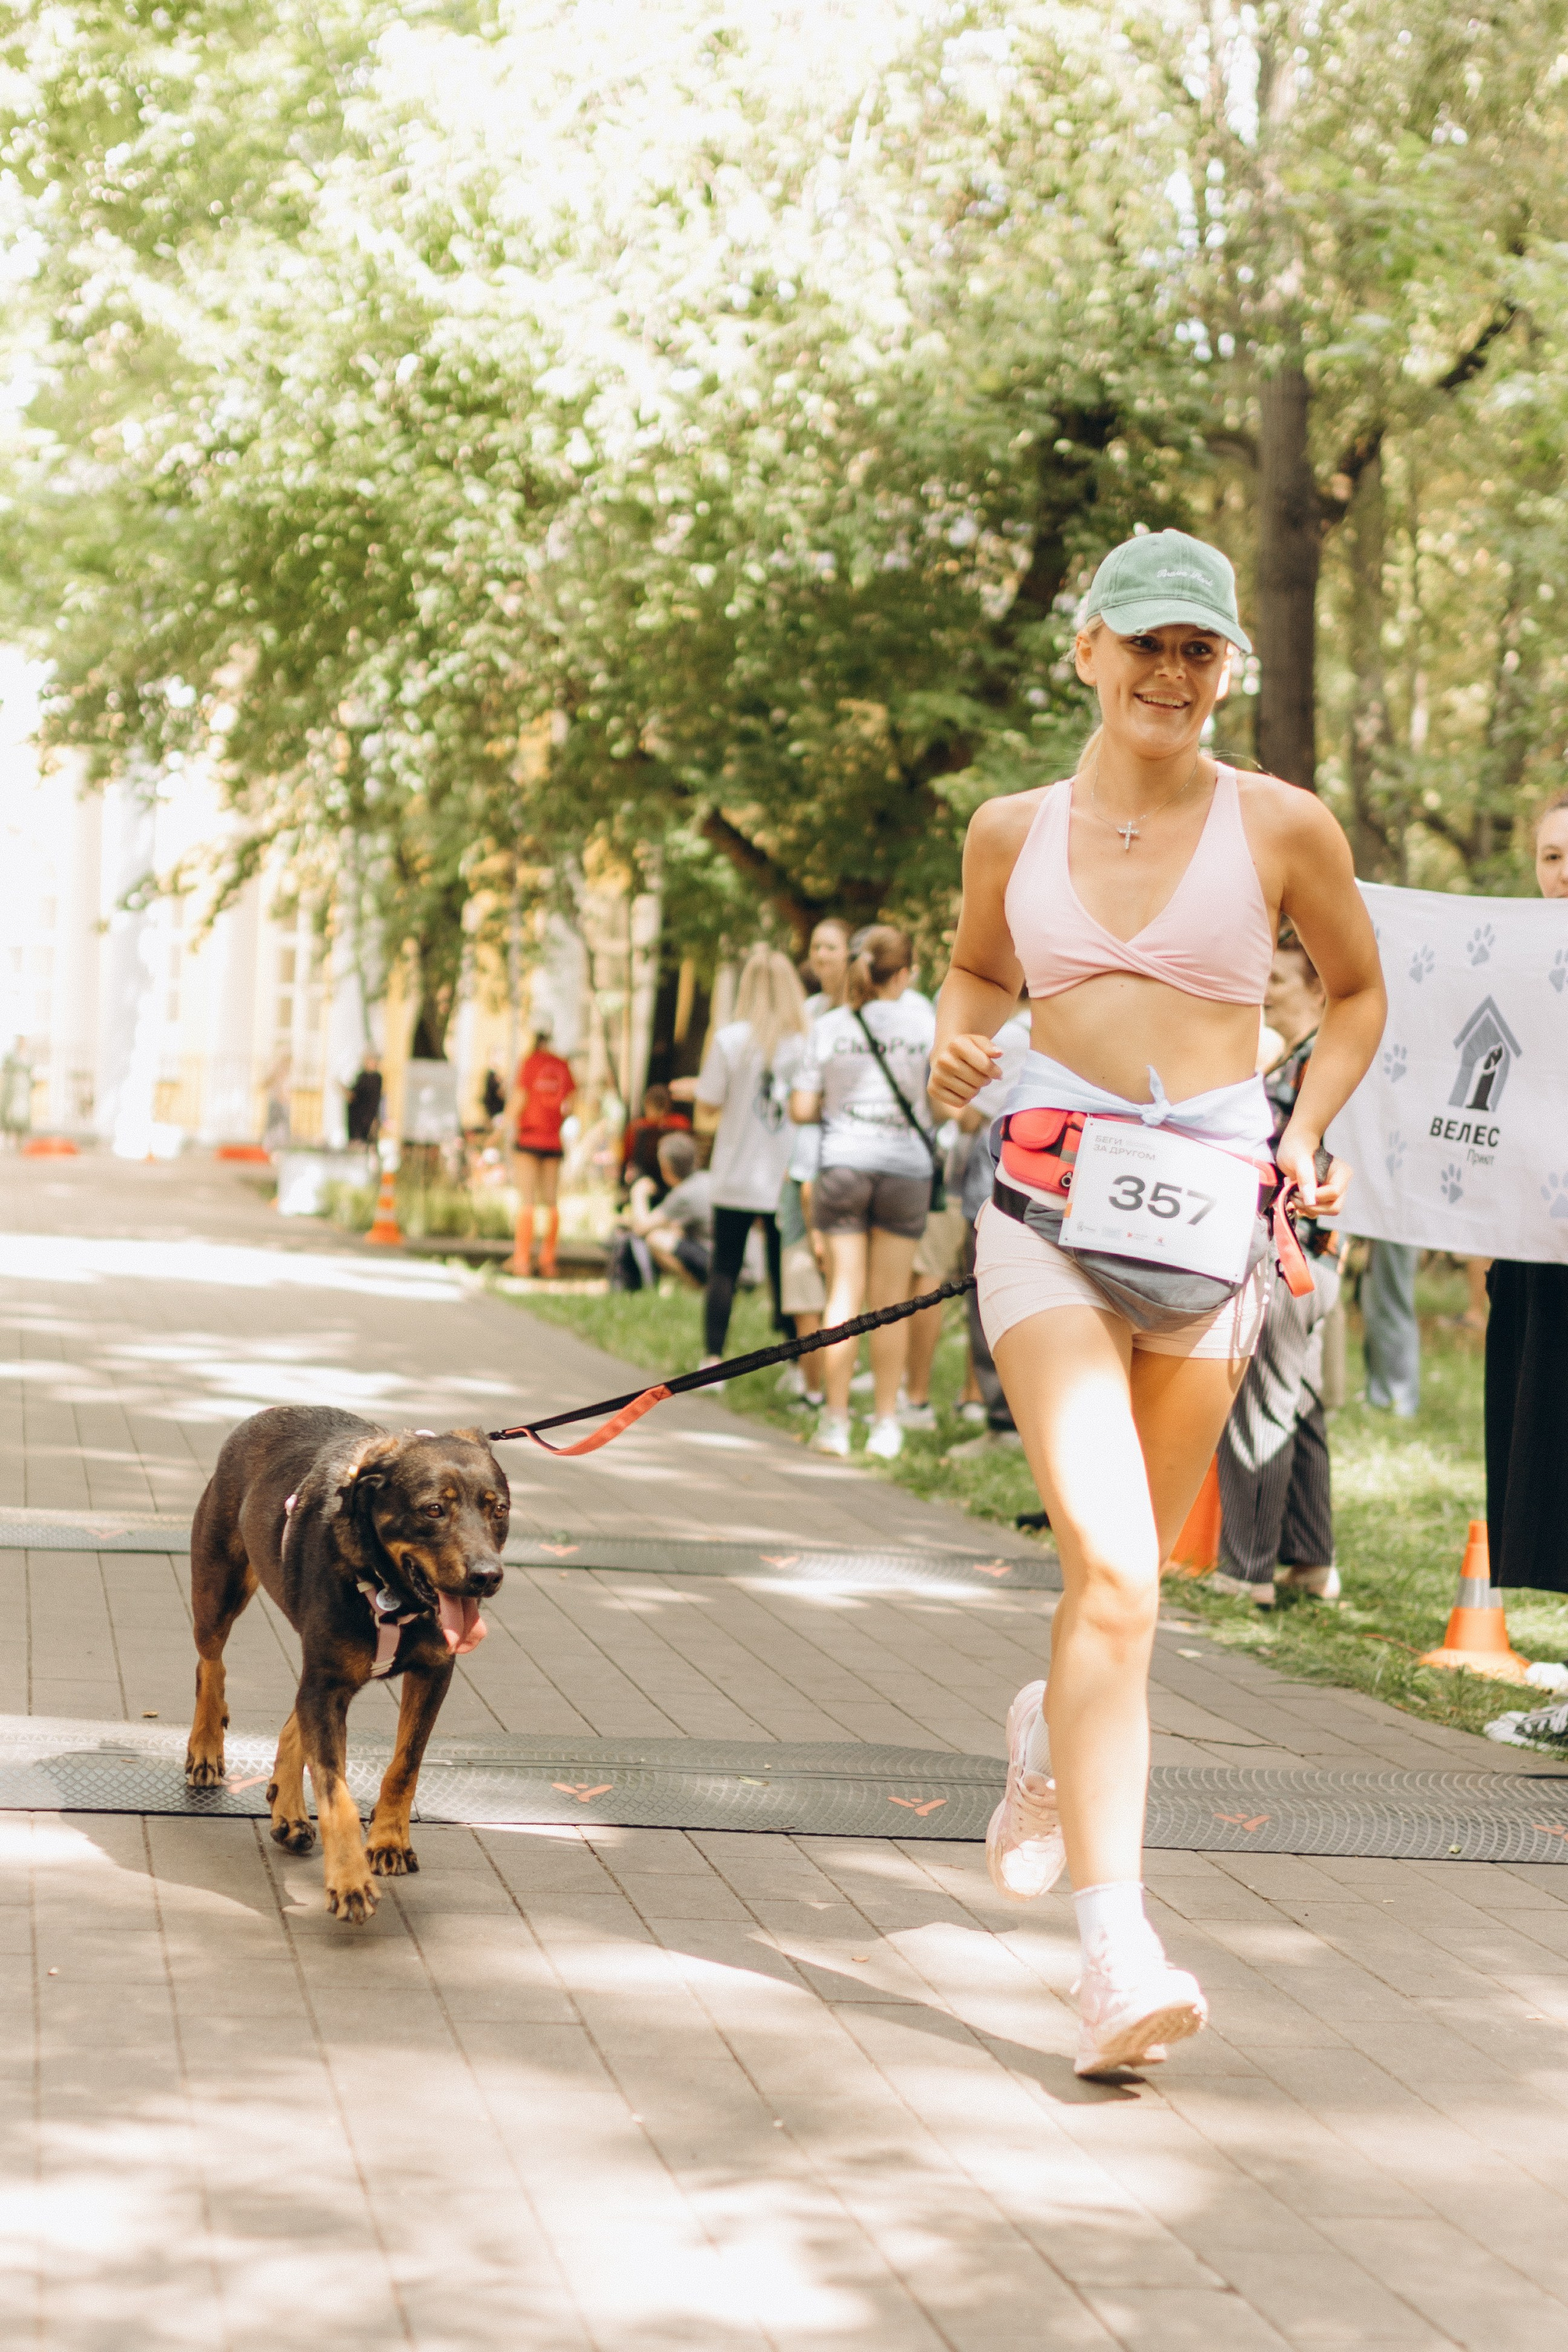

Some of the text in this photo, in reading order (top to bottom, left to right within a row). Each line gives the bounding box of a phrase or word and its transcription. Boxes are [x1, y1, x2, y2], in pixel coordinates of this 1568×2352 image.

[1095, 1135, 1122, 1146] БЕГИ
[1429, 1116, 1501, 1148] ВЕЛЕС
[1093, 1144, 1107, 1153] ЗА
[1109, 1146, 1156, 1161] ДРУГОМ
[1109, 1175, 1217, 1226] 357
